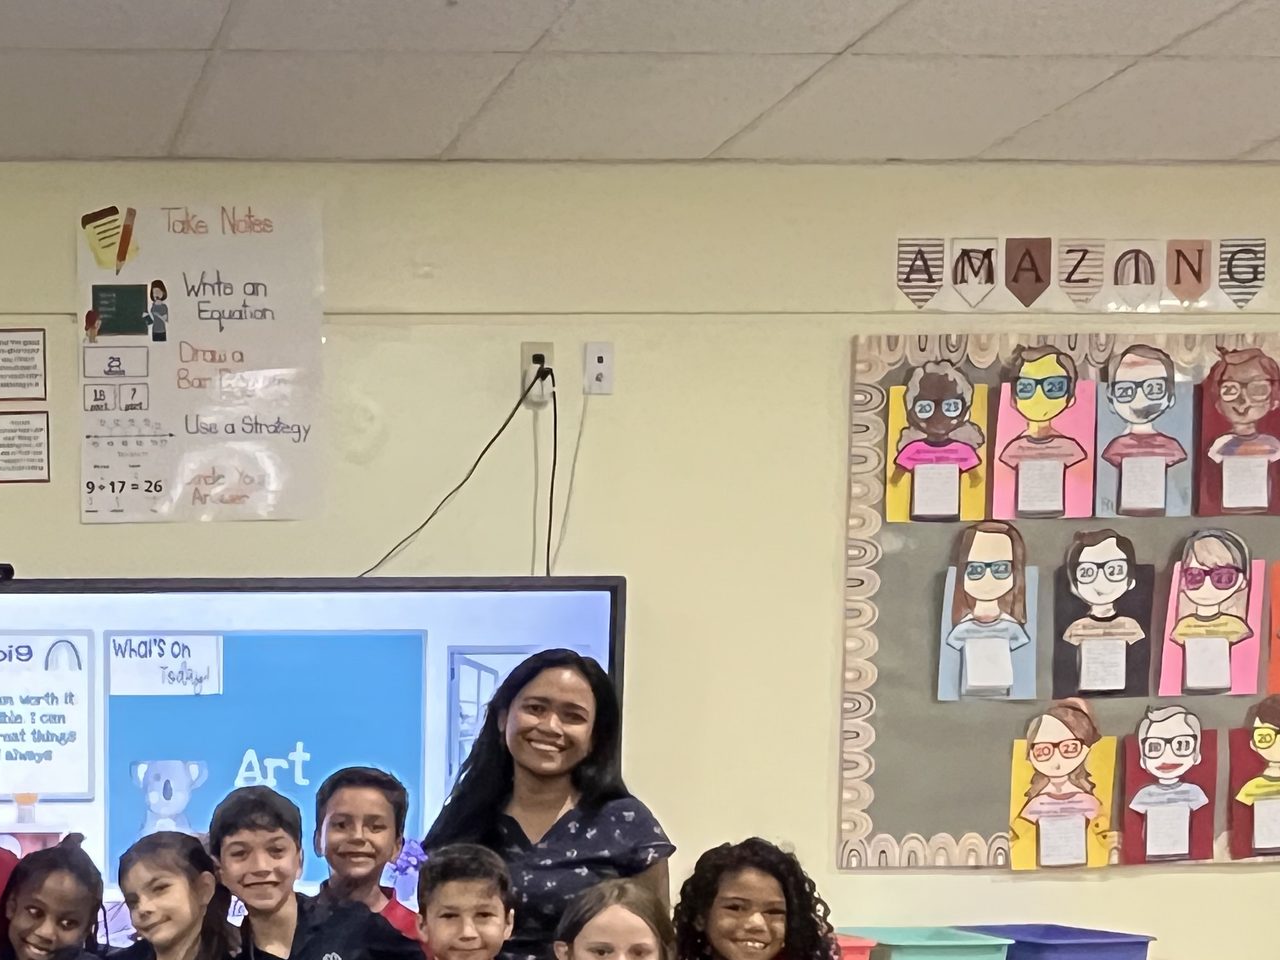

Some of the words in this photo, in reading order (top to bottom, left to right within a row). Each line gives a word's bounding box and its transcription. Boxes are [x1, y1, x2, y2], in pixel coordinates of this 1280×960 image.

[160, 207, 208, 234] Take
[221, 206, 274, 235] Notes
[182, 269, 234, 298] Write
[243, 281, 268, 297] an
[197, 298, 276, 332] Equation
[179, 341, 228, 363] Draw
[232, 350, 244, 363] a
[177, 368, 212, 390] Bar
[1146, 383, 1164, 395] 23
[184, 414, 218, 435] Use
[224, 422, 236, 434] a
[242, 415, 312, 444] Strategy
[86, 481, 95, 494] 9
[109, 480, 126, 494] 17
[144, 480, 163, 493] 26
[1078, 567, 1094, 578] 20
[20, 692, 59, 706] worth
[64, 692, 75, 706] it
[40, 714, 66, 724] can
[30, 728, 77, 746] things
[233, 741, 312, 788] Art
